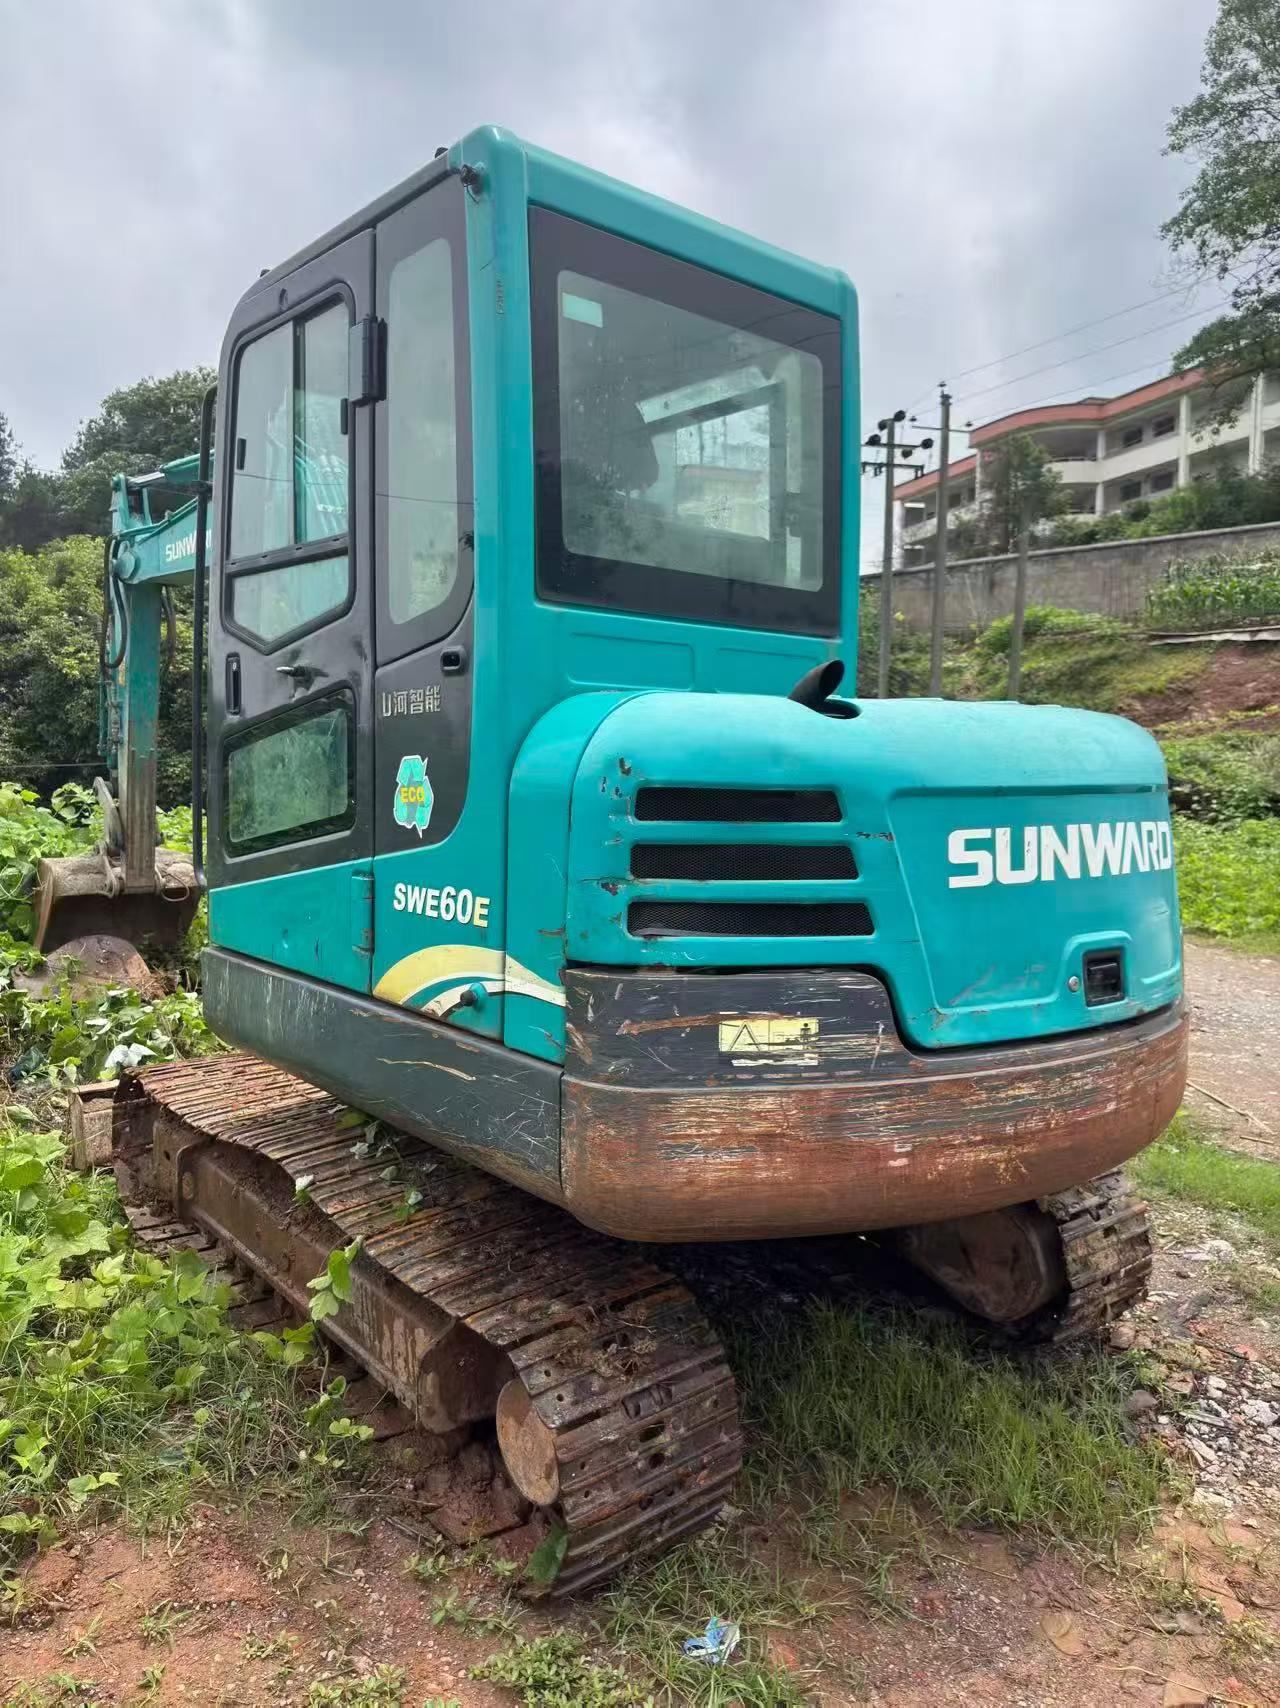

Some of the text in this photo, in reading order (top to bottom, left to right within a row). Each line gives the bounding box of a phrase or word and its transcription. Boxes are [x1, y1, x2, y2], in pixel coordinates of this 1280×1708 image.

[165, 528, 212, 562] SUNW
[399, 785, 425, 803] ECO
[948, 821, 1172, 889] SUNWARD
[393, 882, 490, 928] SWE60E
